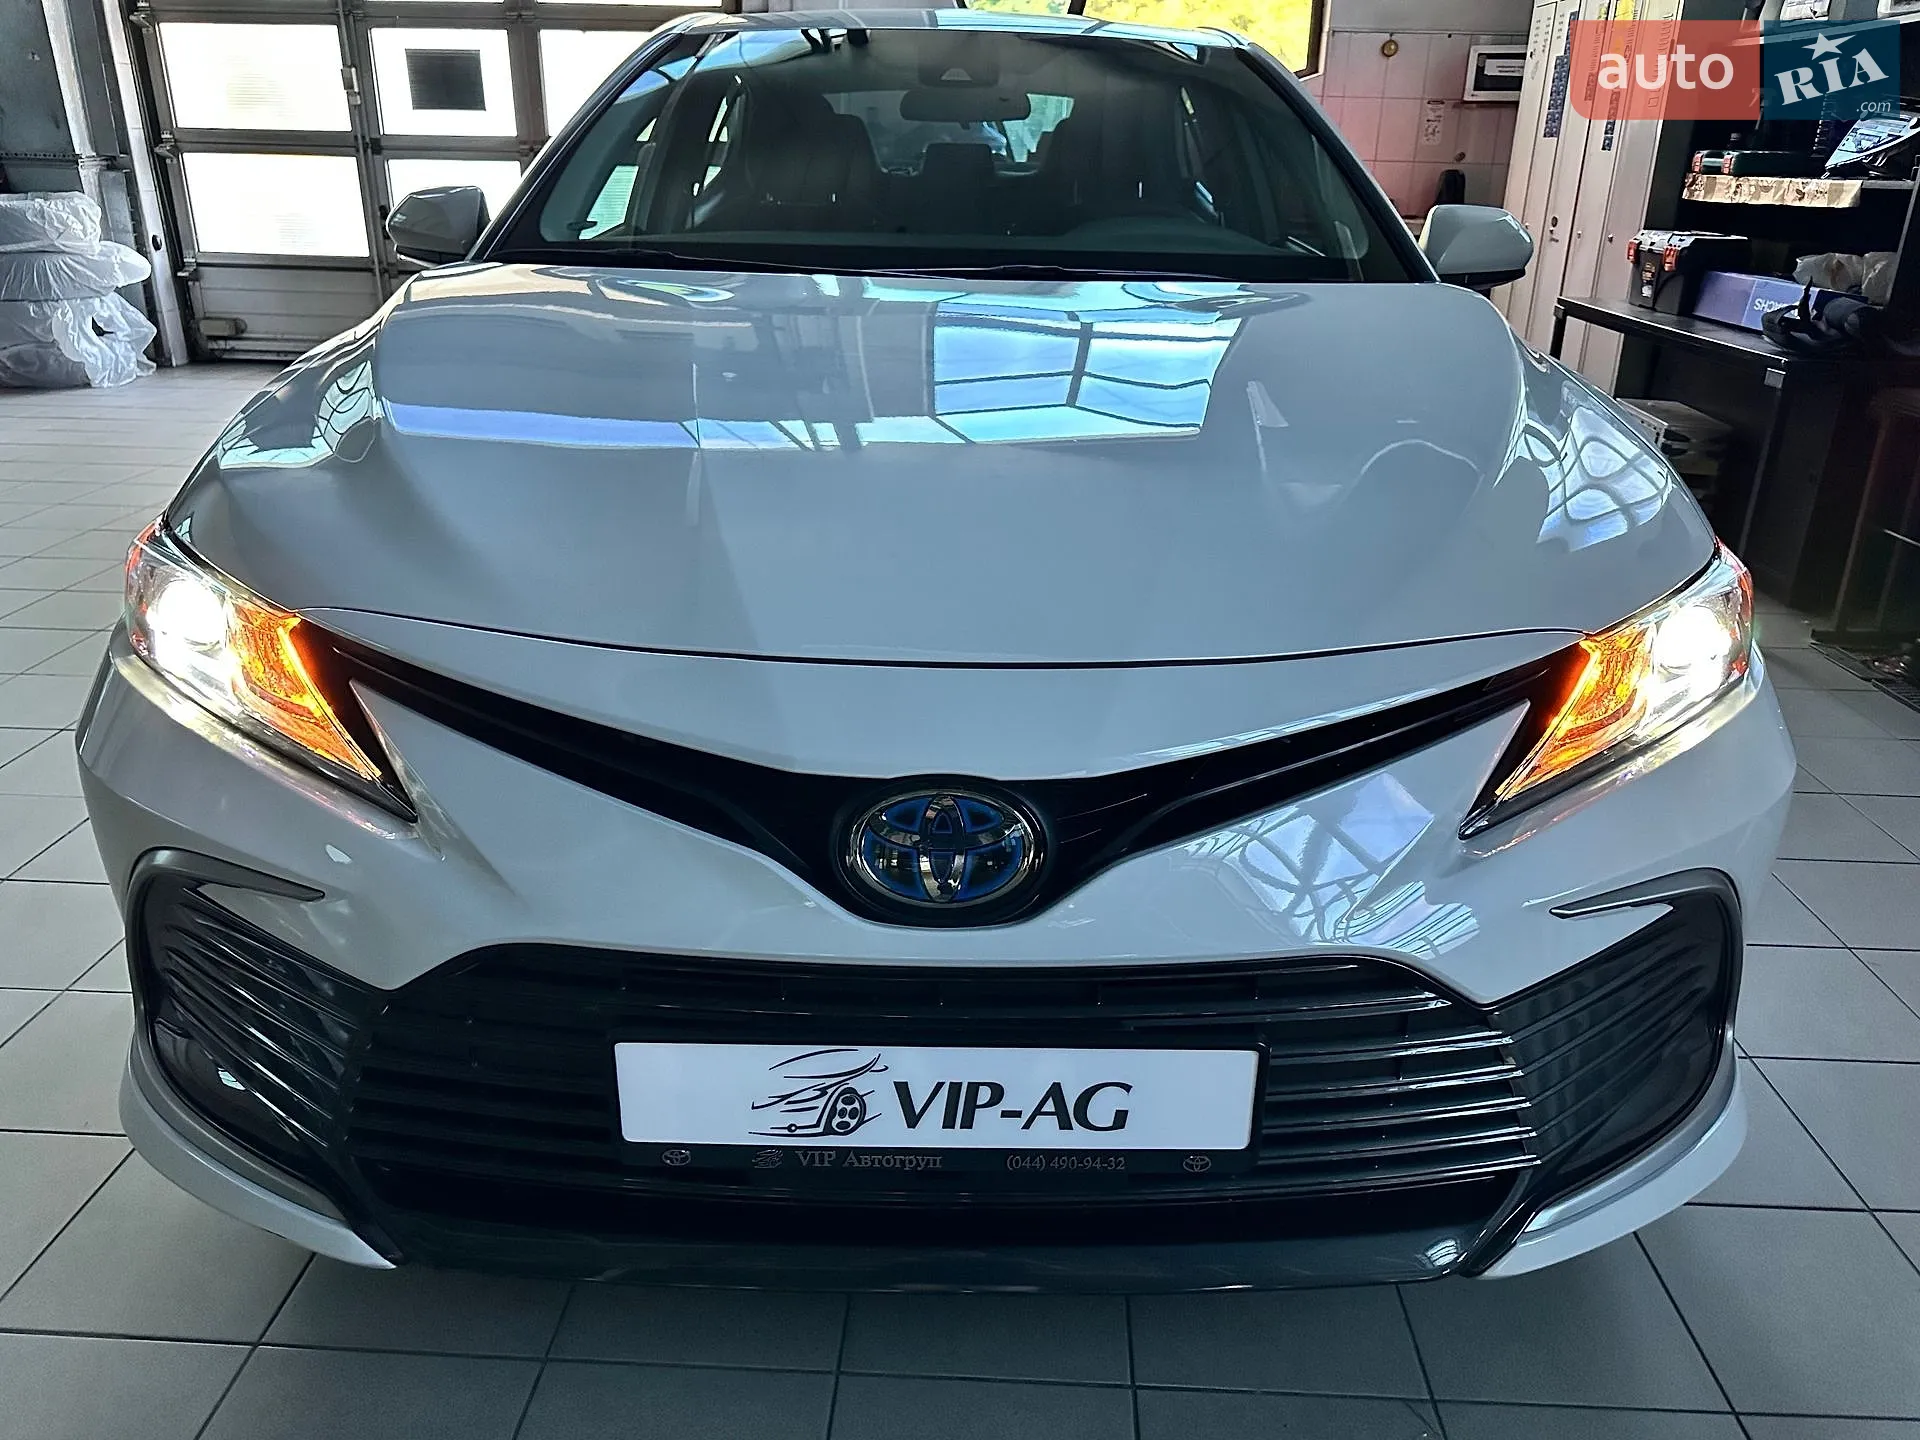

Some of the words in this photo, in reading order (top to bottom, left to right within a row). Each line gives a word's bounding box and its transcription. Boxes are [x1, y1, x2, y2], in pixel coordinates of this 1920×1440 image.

[892, 1080, 1134, 1132] VIP-AG
[795, 1150, 837, 1167] VIP
[842, 1150, 943, 1171] Автогруп
[1006, 1154, 1047, 1172] (044)
[1050, 1155, 1126, 1171] 490-94-32
